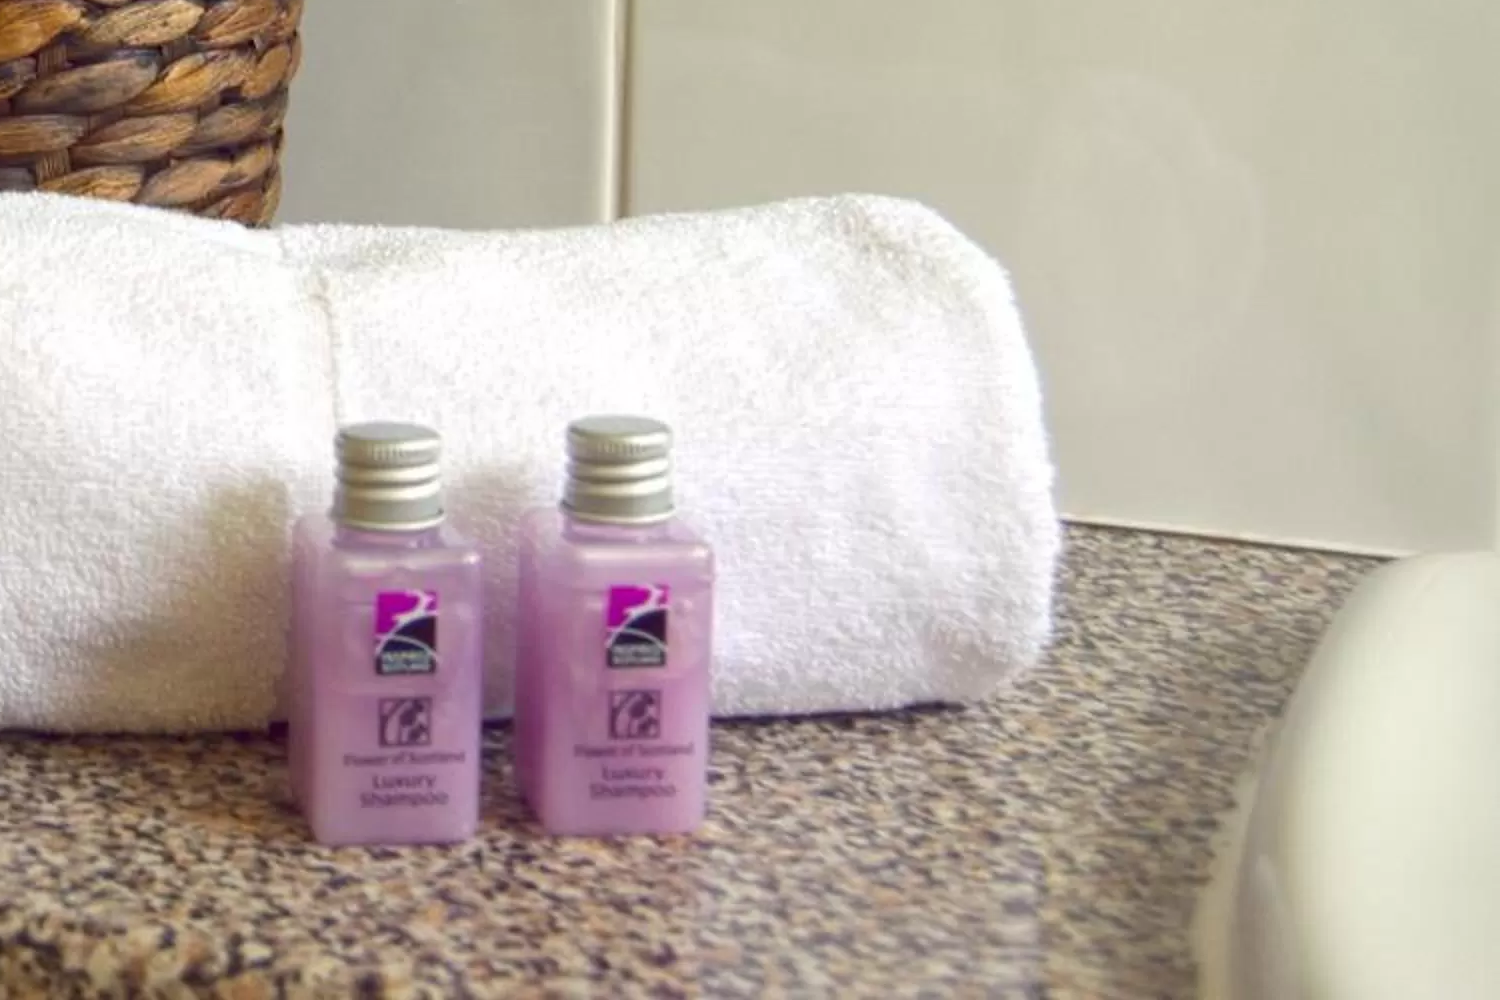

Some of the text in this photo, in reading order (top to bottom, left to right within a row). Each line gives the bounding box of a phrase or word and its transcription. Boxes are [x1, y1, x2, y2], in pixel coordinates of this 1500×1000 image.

[601, 764, 665, 782] Luxury
[371, 774, 437, 790] Luxury
[359, 791, 449, 808] Shampoo
[588, 782, 676, 800] Shampoo
